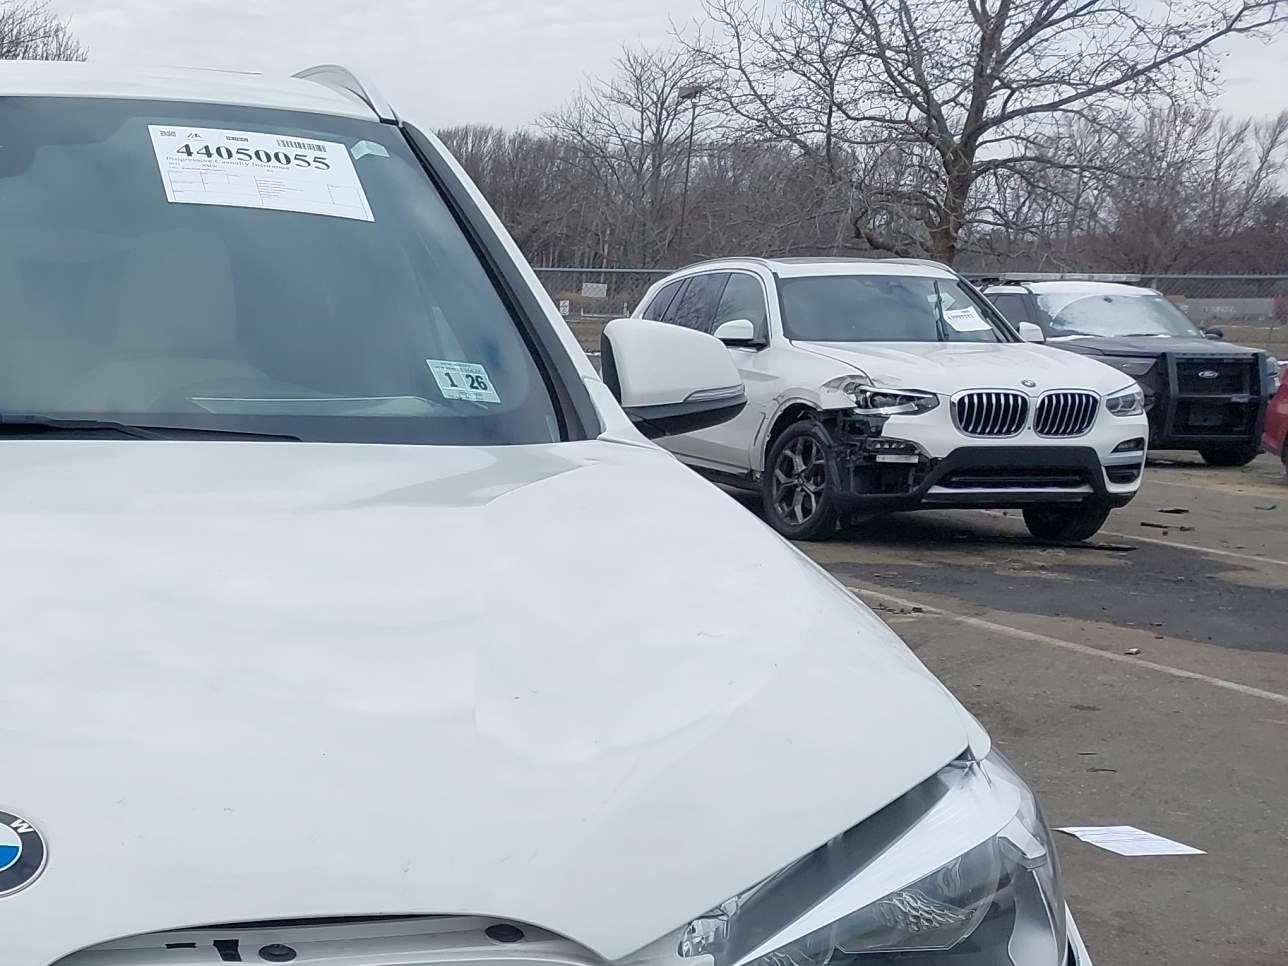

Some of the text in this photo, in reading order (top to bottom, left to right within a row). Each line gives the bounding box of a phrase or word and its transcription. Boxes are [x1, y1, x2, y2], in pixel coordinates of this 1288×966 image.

[176, 143, 331, 170] 44050055
[444, 372, 487, 390] 1 26
